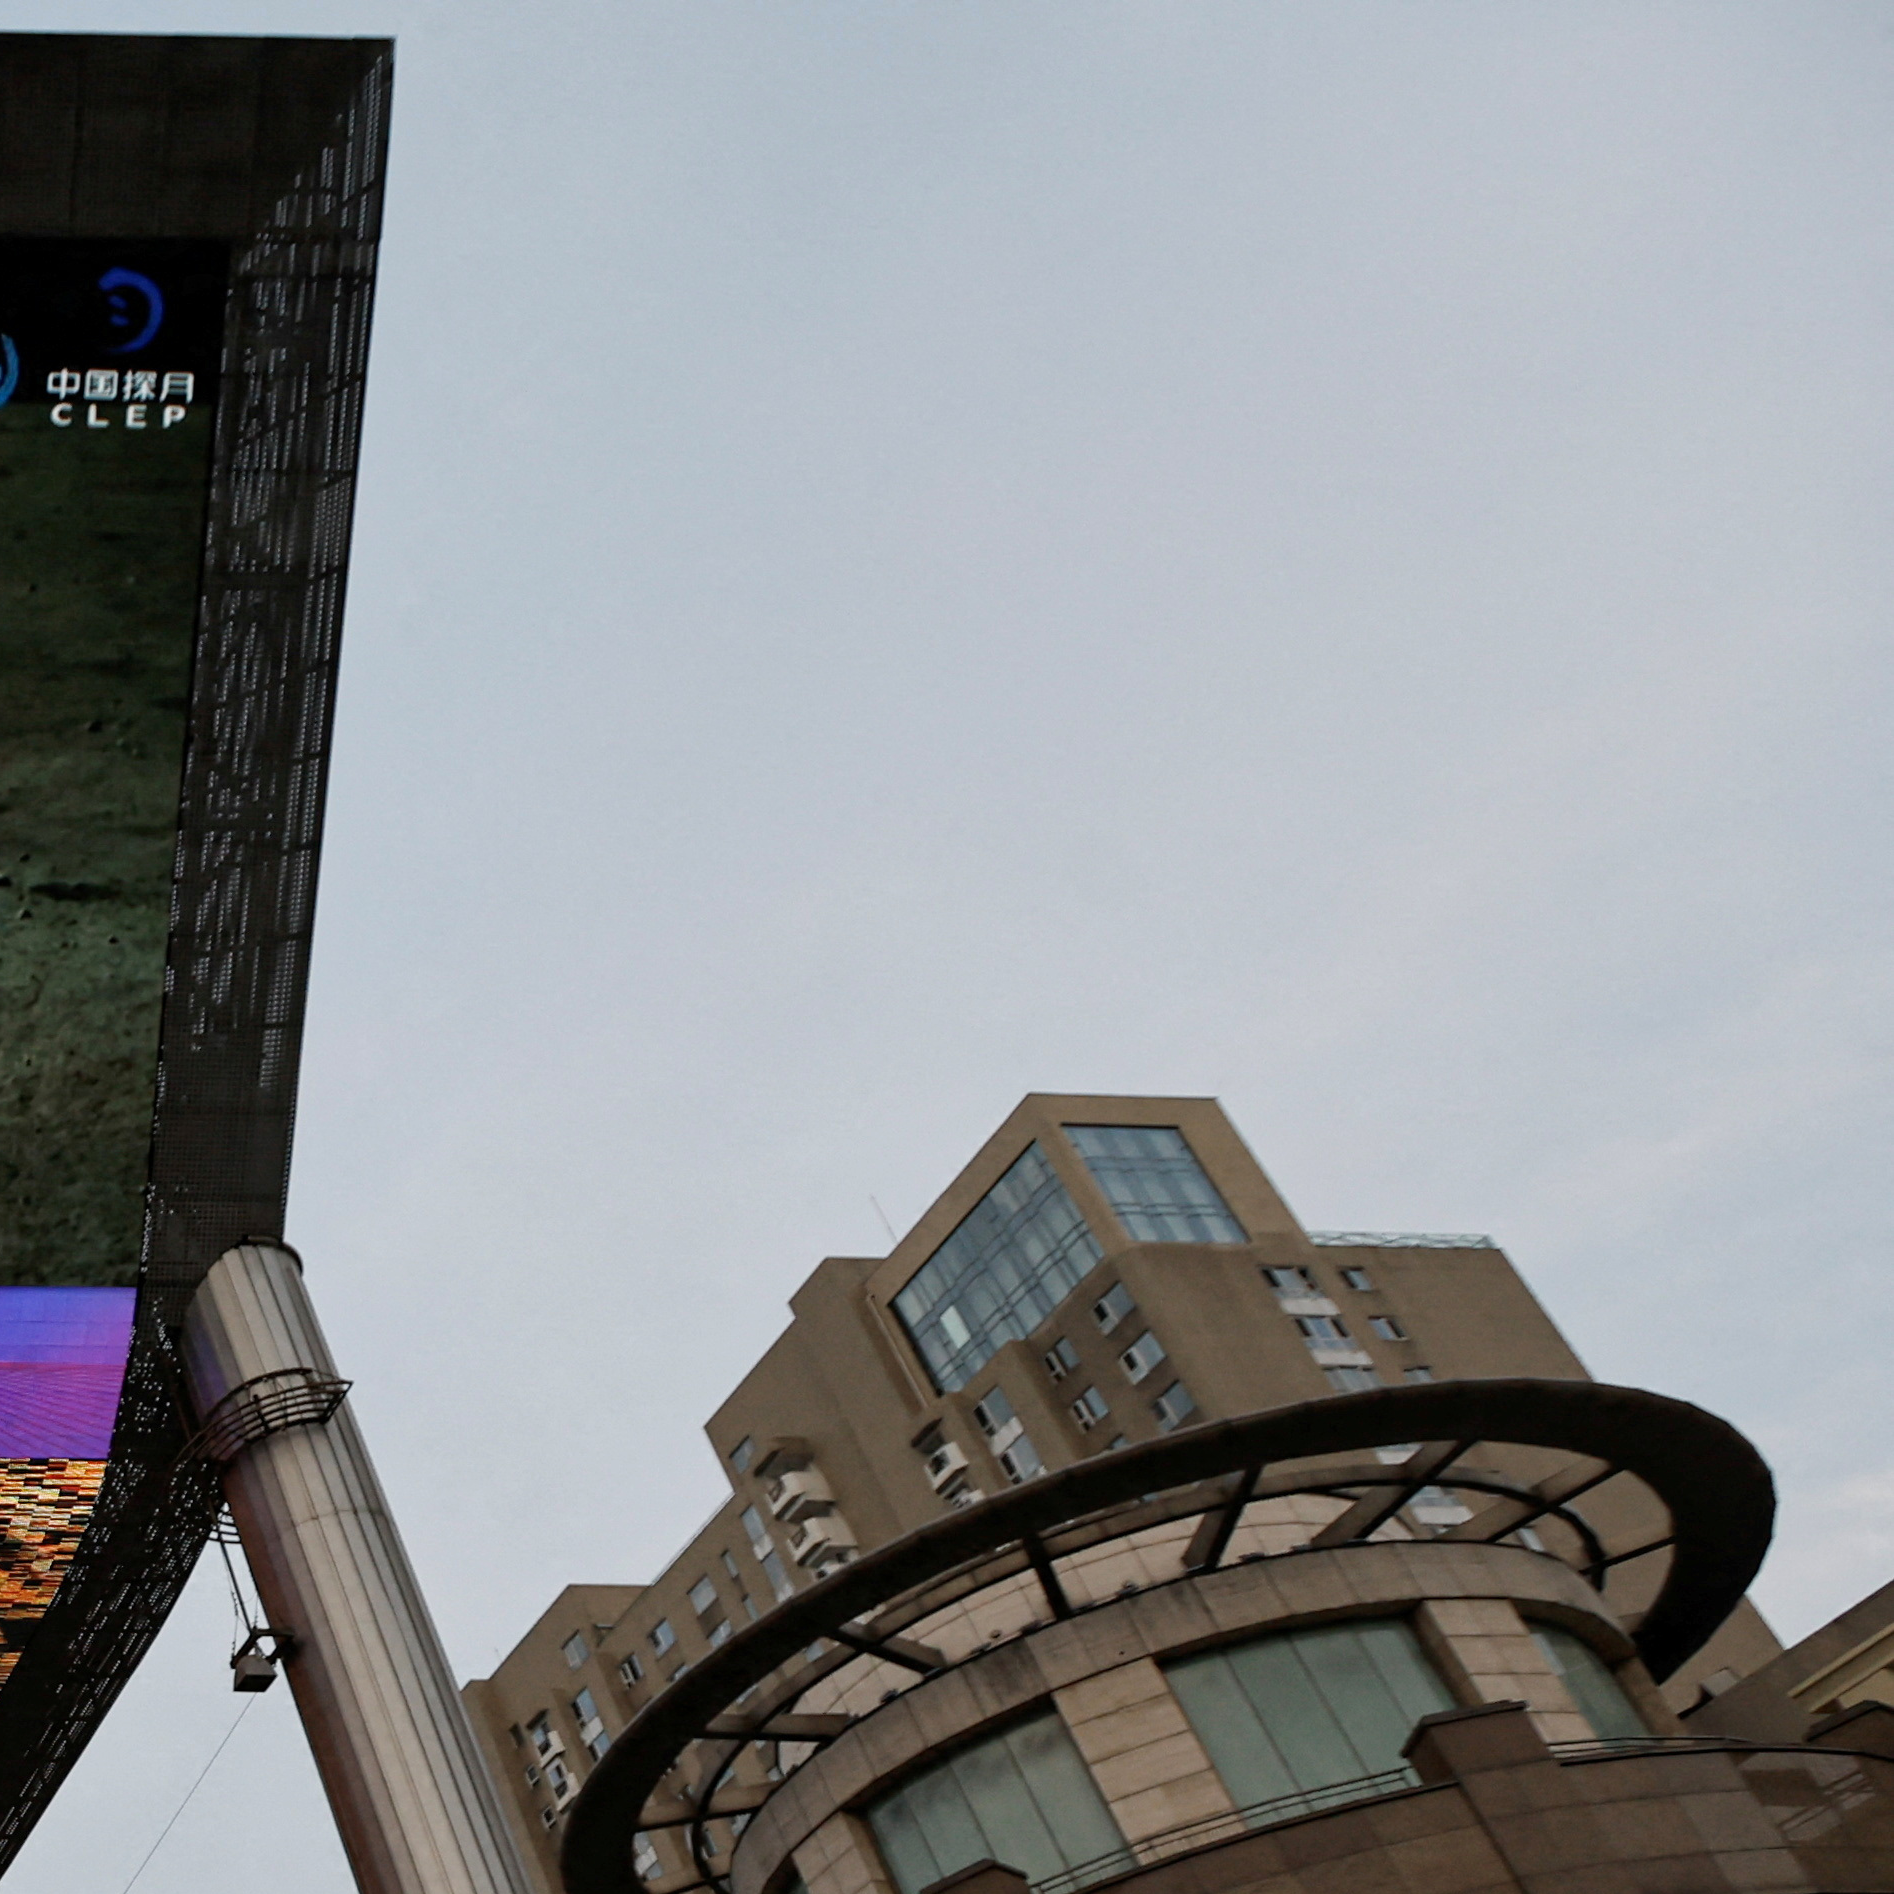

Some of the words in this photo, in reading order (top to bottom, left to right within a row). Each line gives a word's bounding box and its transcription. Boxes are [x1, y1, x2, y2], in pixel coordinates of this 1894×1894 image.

[46, 368, 195, 402] 中国探月
[50, 403, 186, 429] CLEP
